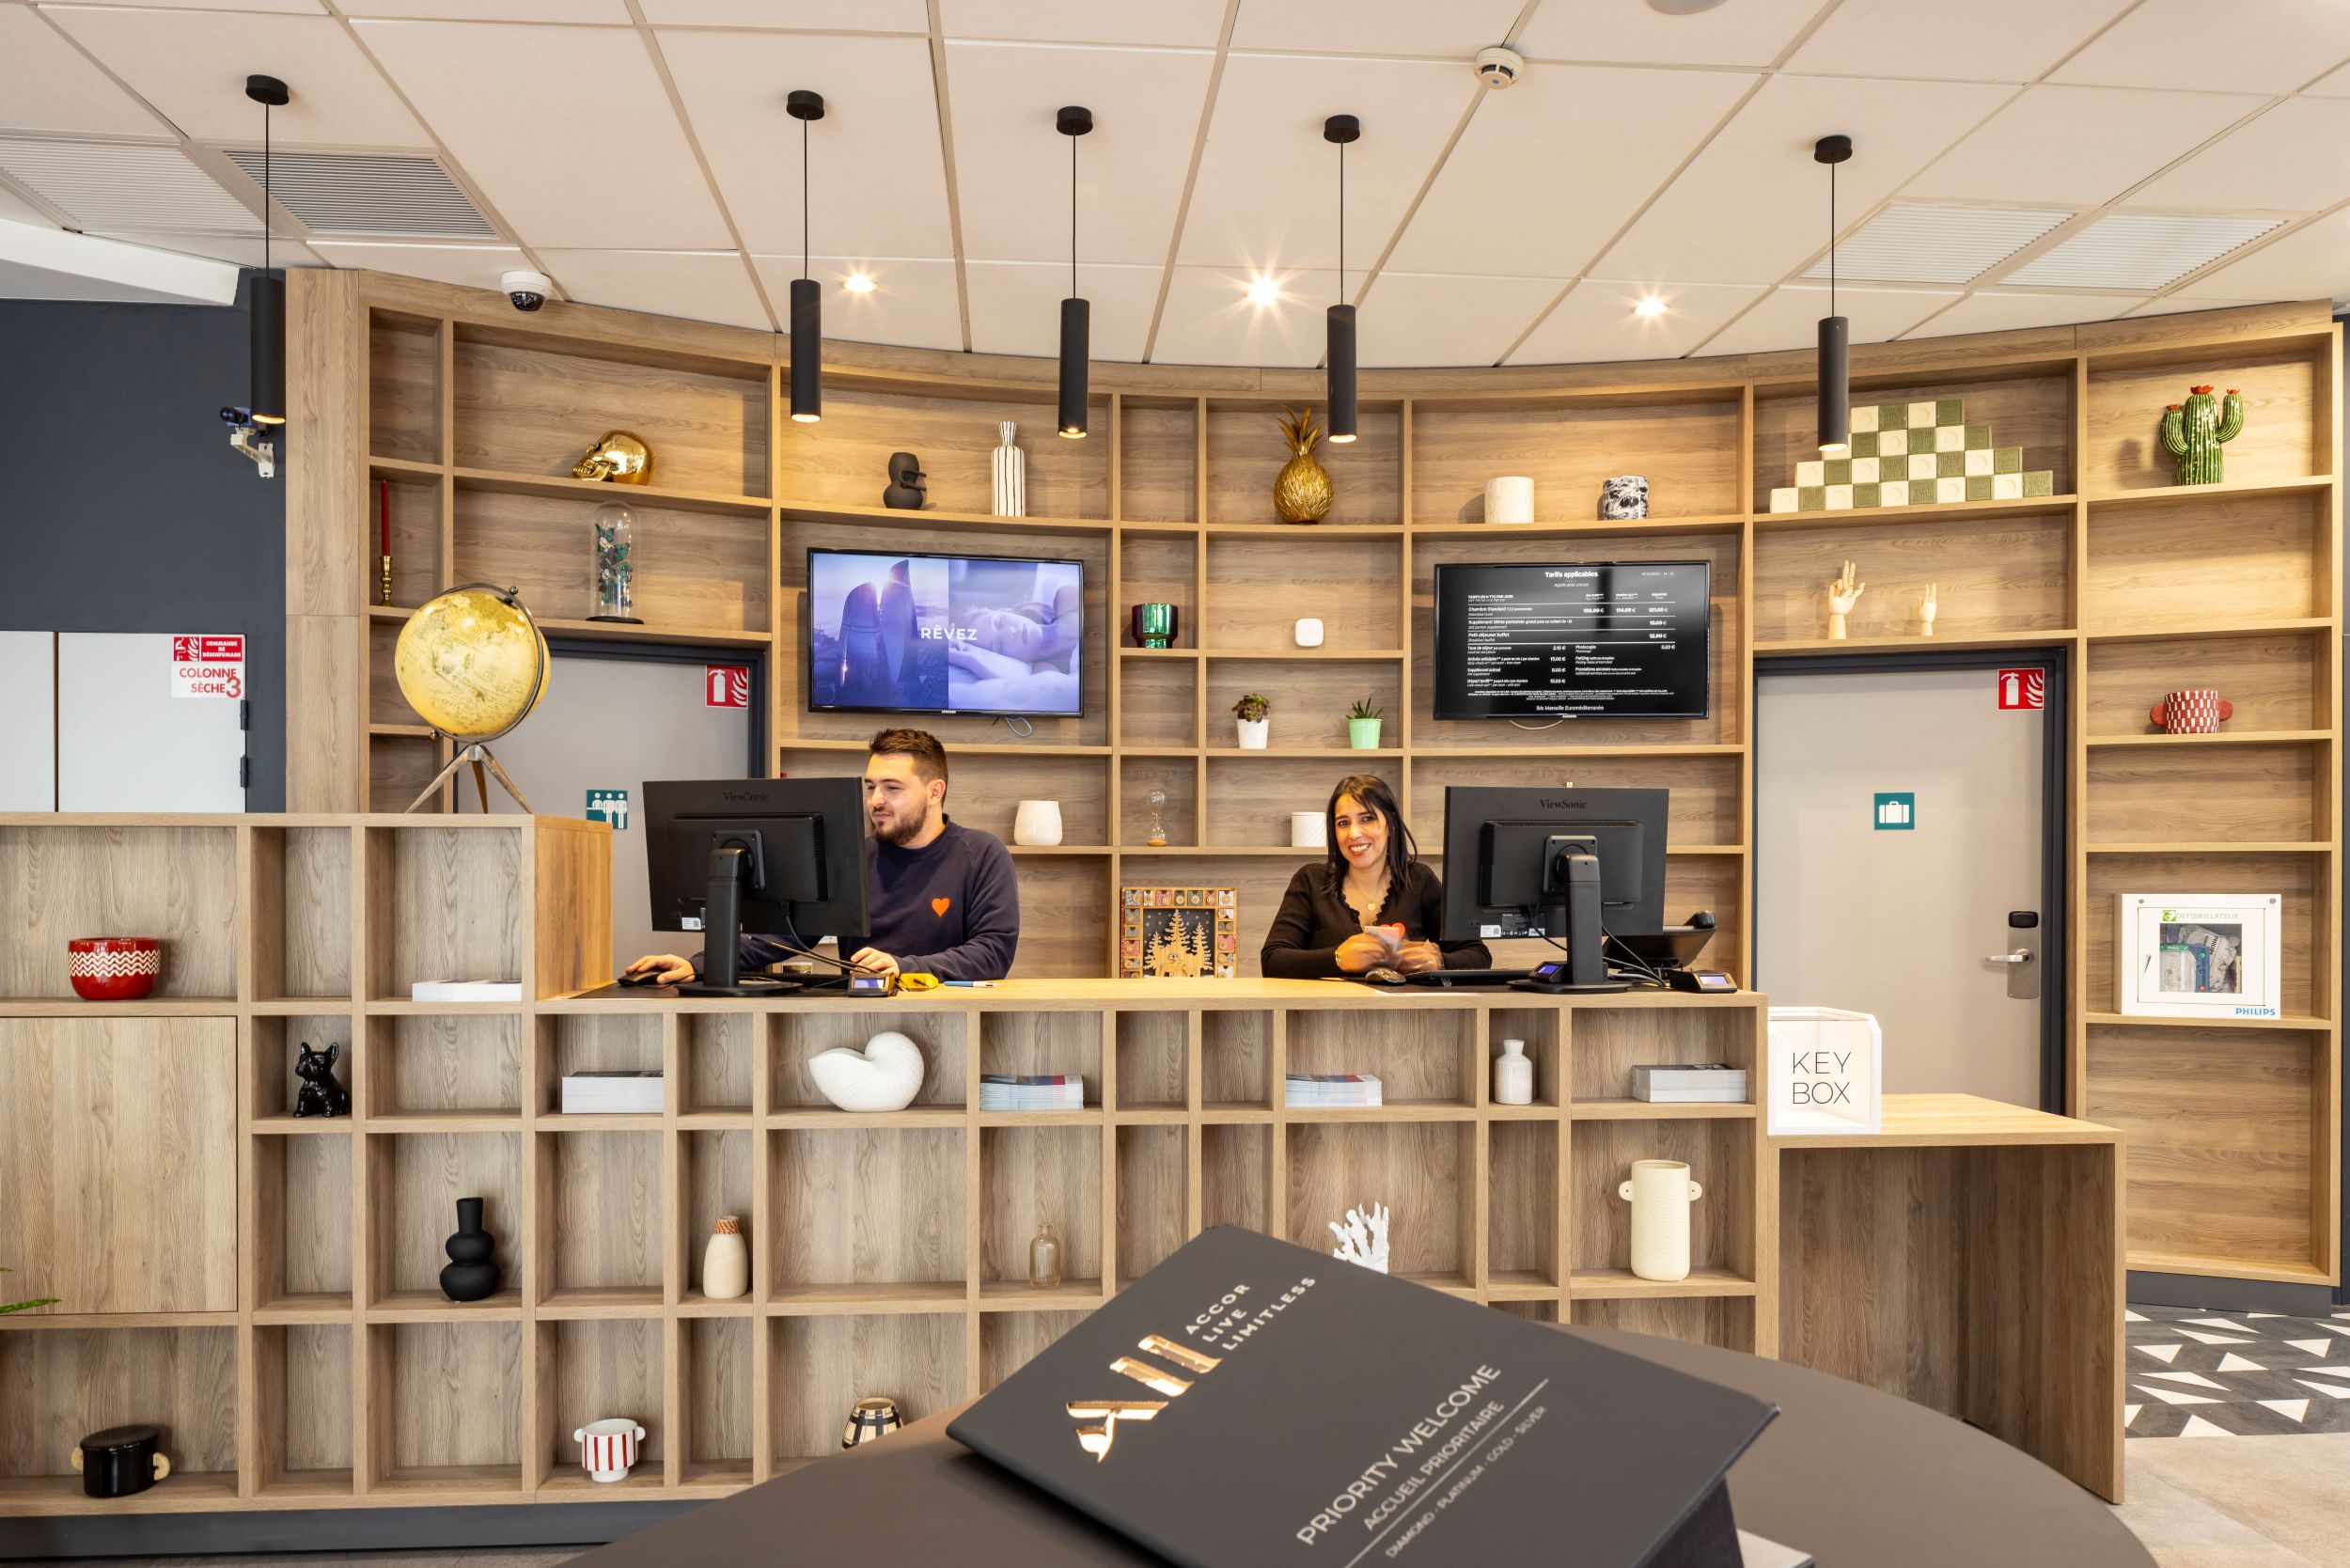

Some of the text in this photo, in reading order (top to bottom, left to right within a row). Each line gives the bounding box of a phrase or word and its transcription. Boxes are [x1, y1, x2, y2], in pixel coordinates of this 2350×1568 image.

[920, 626, 978, 641] RÊVEZ
[179, 667, 237, 678] COLONNE
[191, 677, 241, 698] SÈCHE 3
[1540, 799, 1587, 808] ViewSonic
[2235, 1007, 2276, 1015] PHILIPS
[1793, 1051, 1852, 1074] KEY
[1793, 1081, 1851, 1104] BOX
[1185, 1284, 1250, 1335] ACCOR
[1222, 1278, 1316, 1350] LIMITLESS
[1201, 1309, 1246, 1342] LIVE
[1296, 1364, 1501, 1545] PRIORITY WELCOME
[1363, 1401, 1504, 1531] ACCUEIL PRIORITAIRE
[1386, 1405, 1547, 1559] DIAMOND PLATINUM GOLD SILVER
